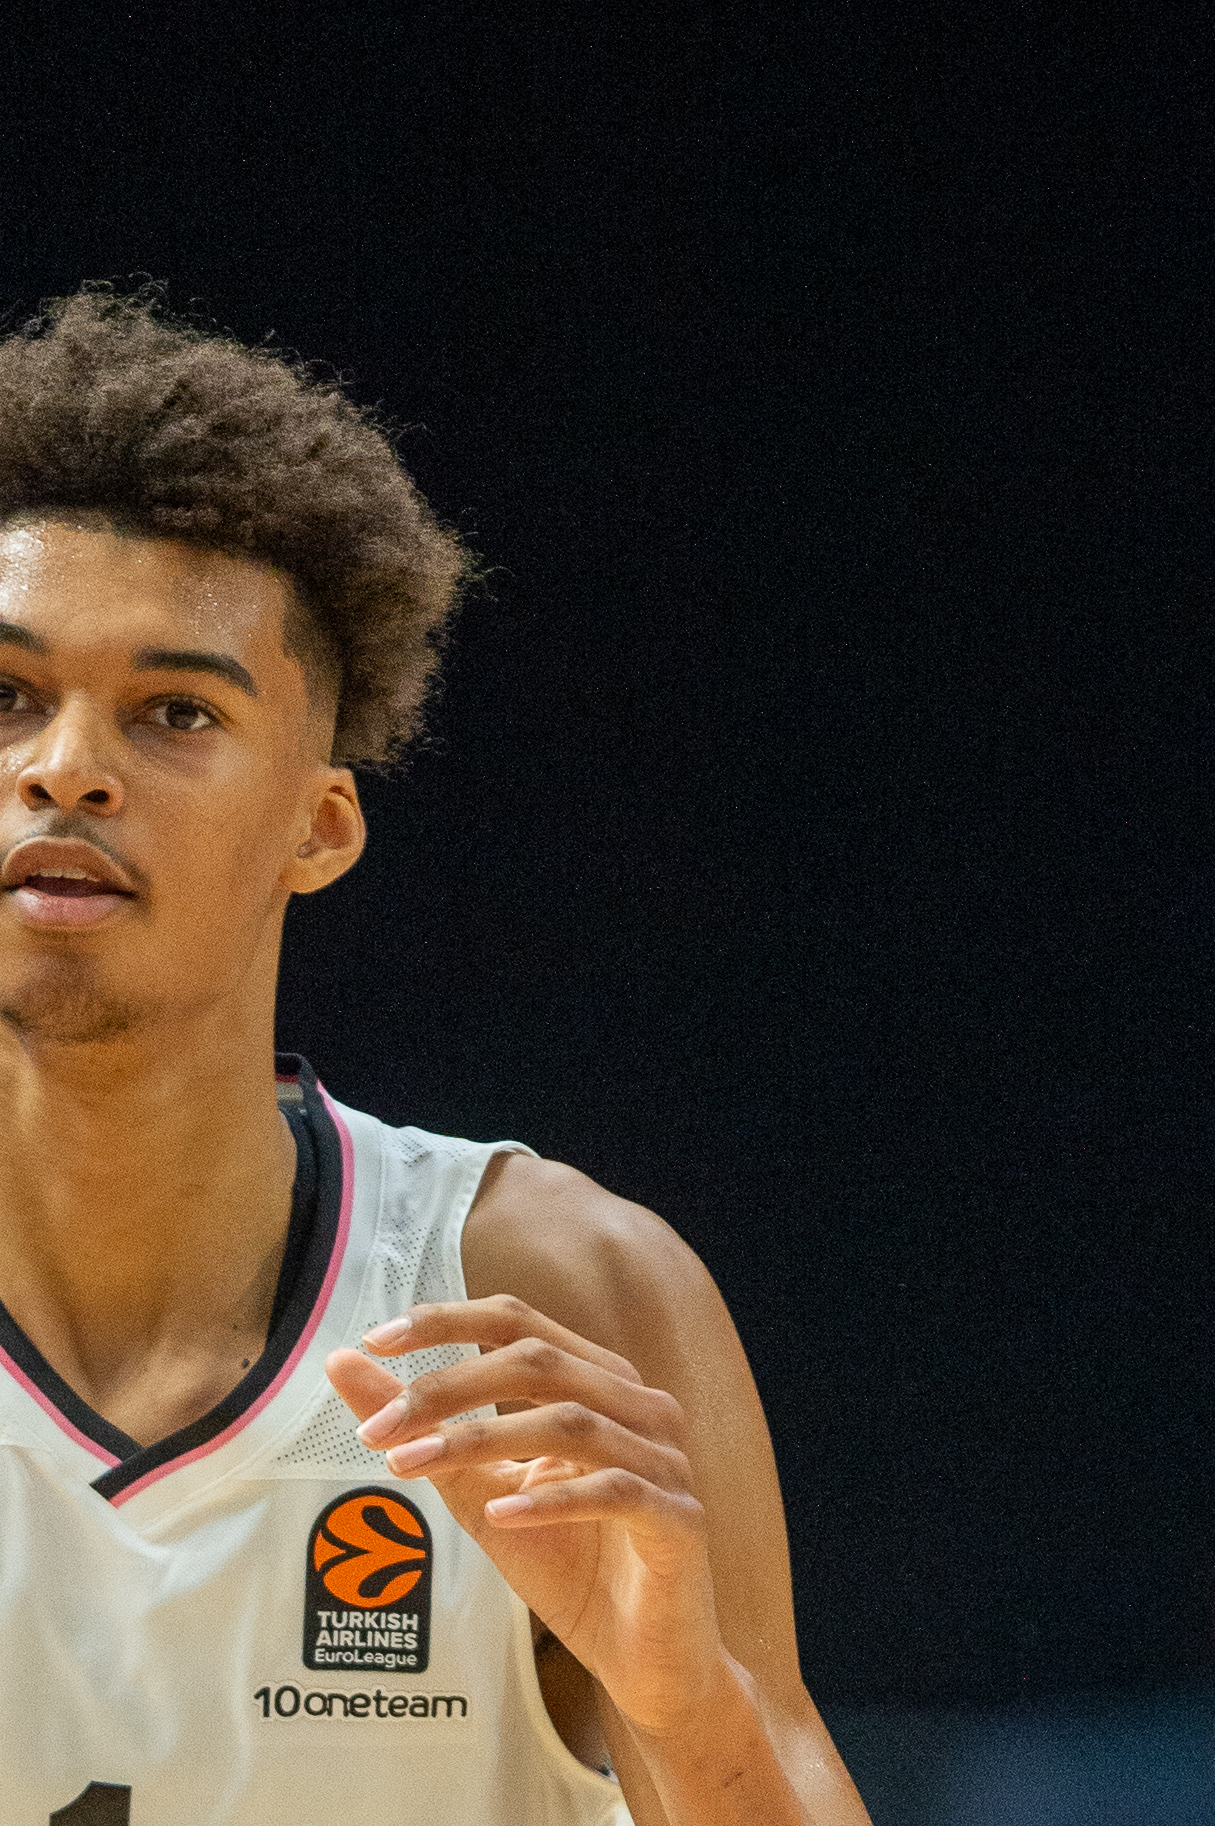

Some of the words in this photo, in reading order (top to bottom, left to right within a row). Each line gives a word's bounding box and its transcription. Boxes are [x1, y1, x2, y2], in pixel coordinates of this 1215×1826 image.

[317, 1610, 419, 1631] TURKISH
[315, 1630, 418, 1648] AIRLINES
[314, 1648, 417, 1668] EuroLeague
